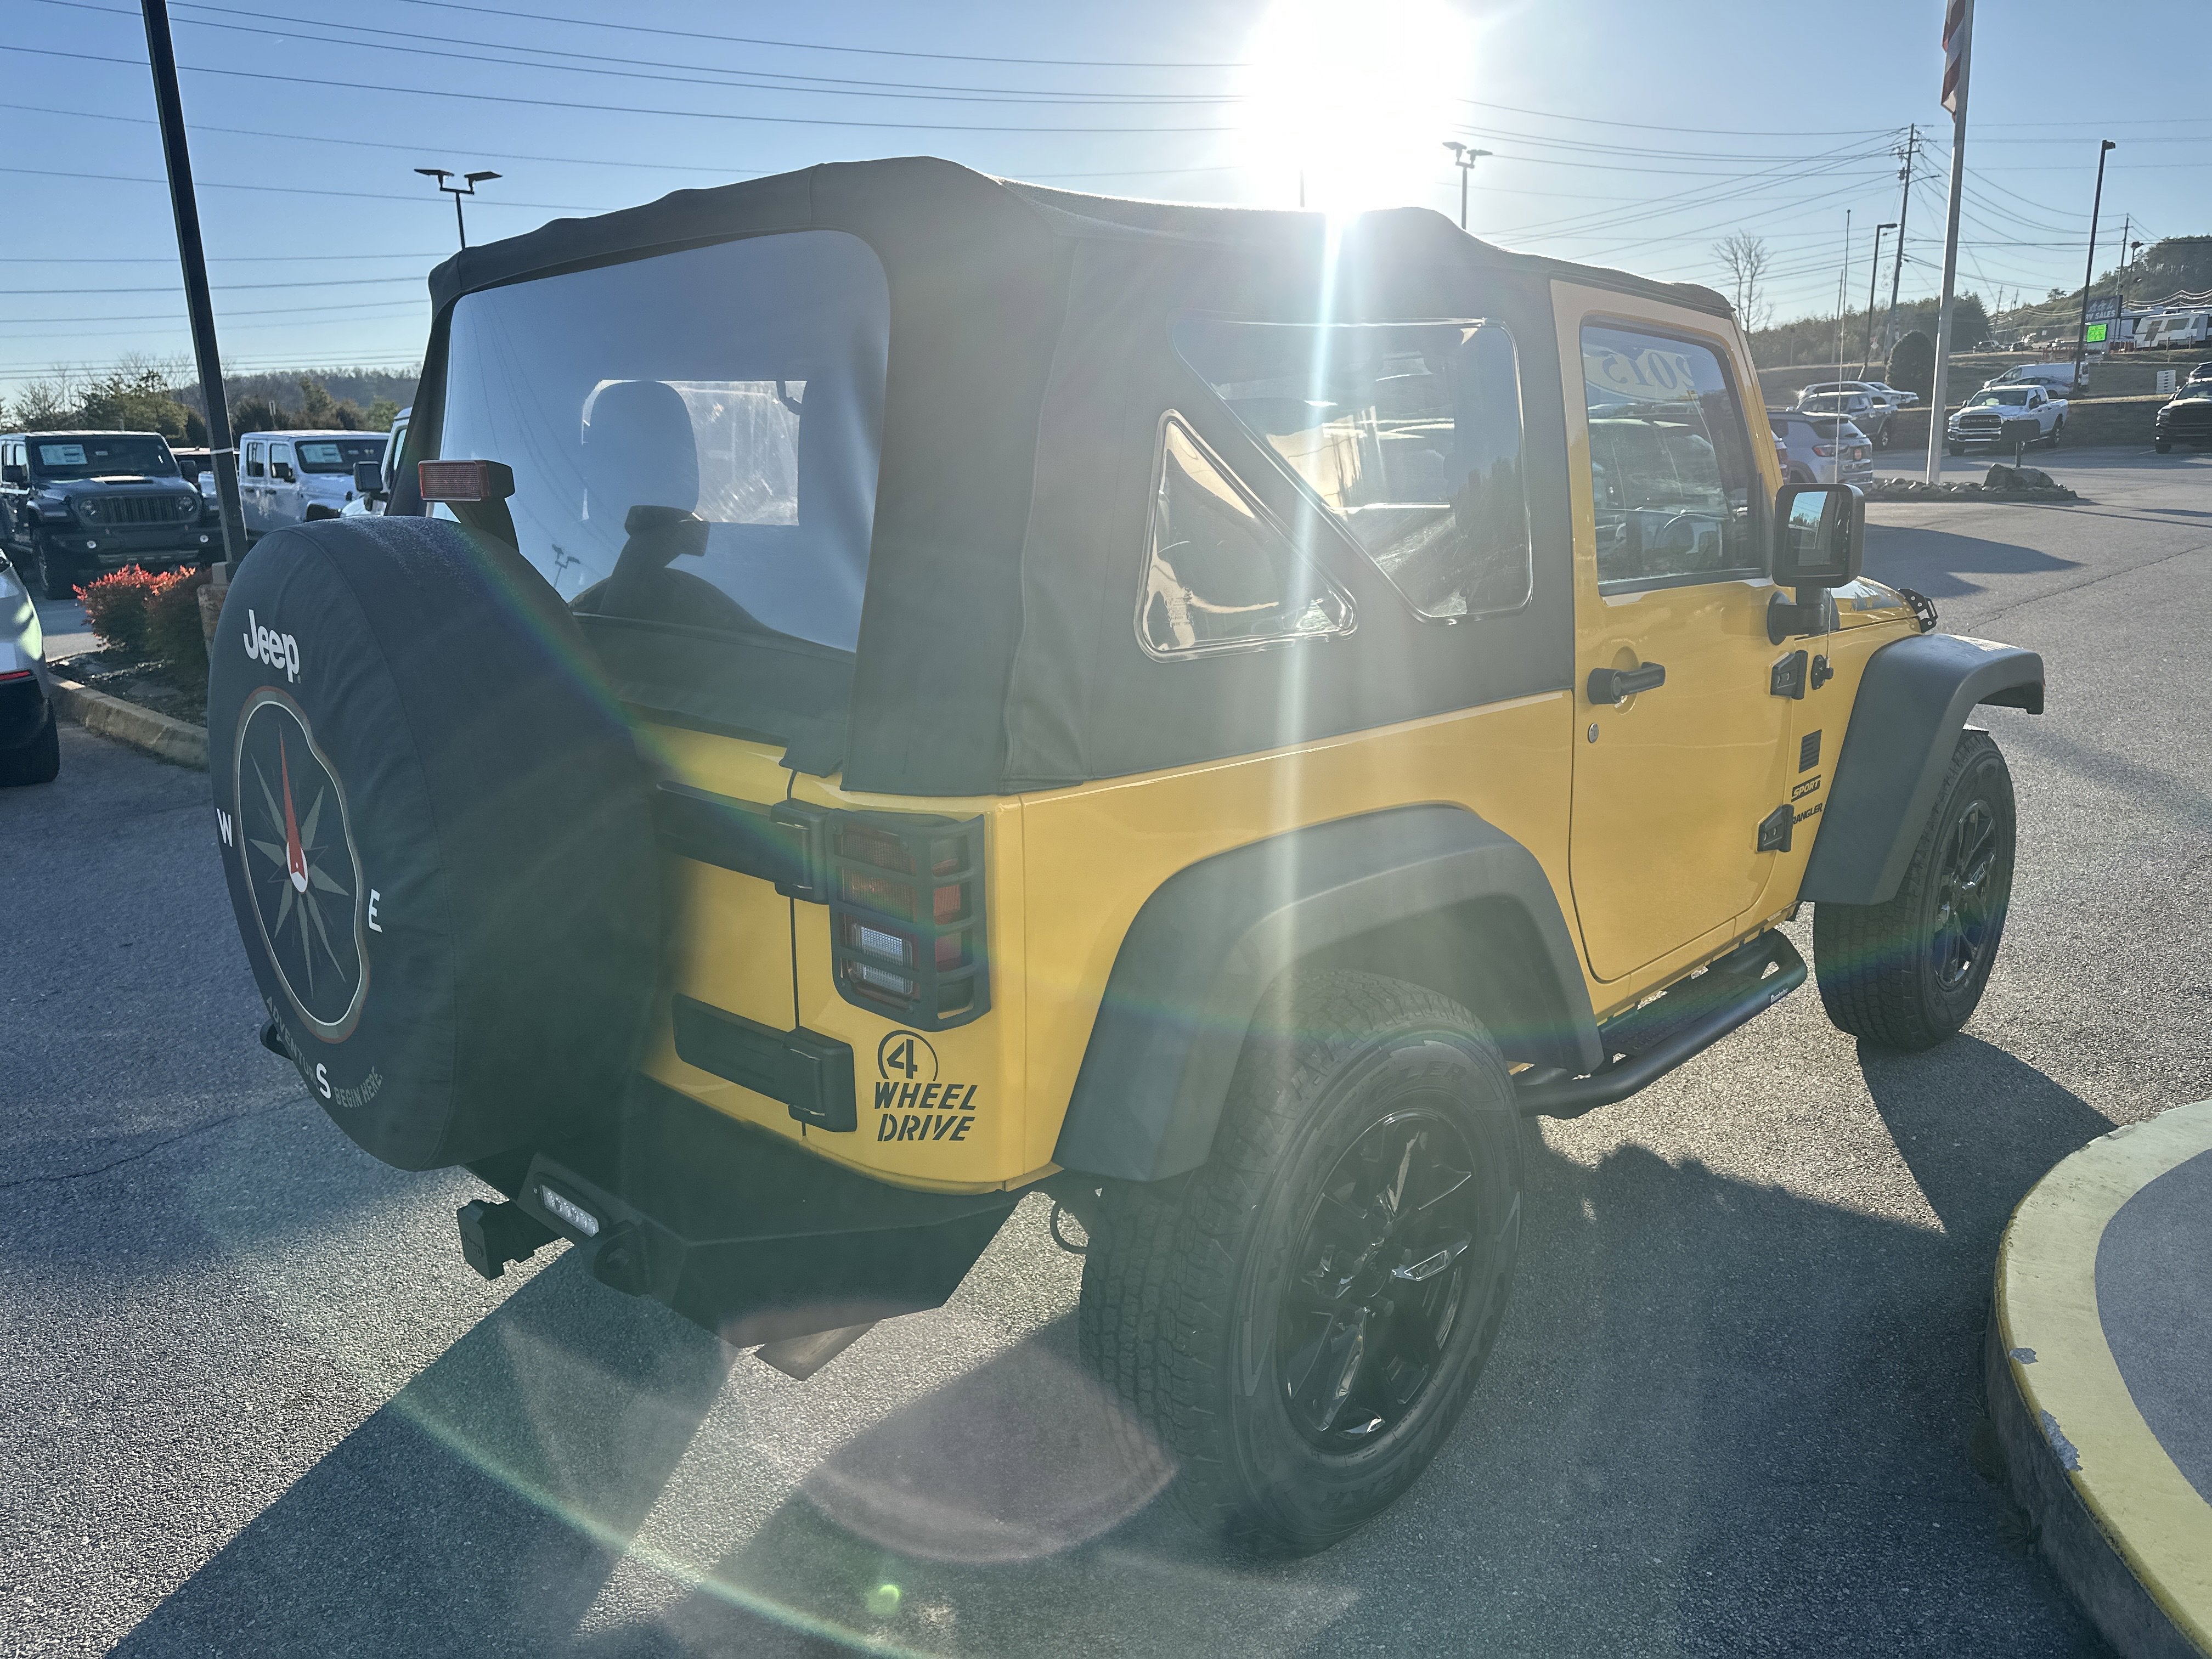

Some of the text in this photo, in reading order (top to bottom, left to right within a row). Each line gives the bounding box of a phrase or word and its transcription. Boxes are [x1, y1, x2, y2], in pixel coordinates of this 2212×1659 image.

[2095, 311, 2115, 319] SALES
[243, 609, 300, 683] Jeep
[1792, 778, 1821, 798] SPORT
[217, 808, 232, 847] W
[1792, 803, 1822, 825] RANGLER
[368, 889, 382, 933] E
[887, 1039, 918, 1079] 4
[317, 1063, 331, 1099] S
[334, 1086, 363, 1108] BEGIN
[874, 1082, 978, 1110] WHEEL
[877, 1113, 975, 1142] DRIVE
